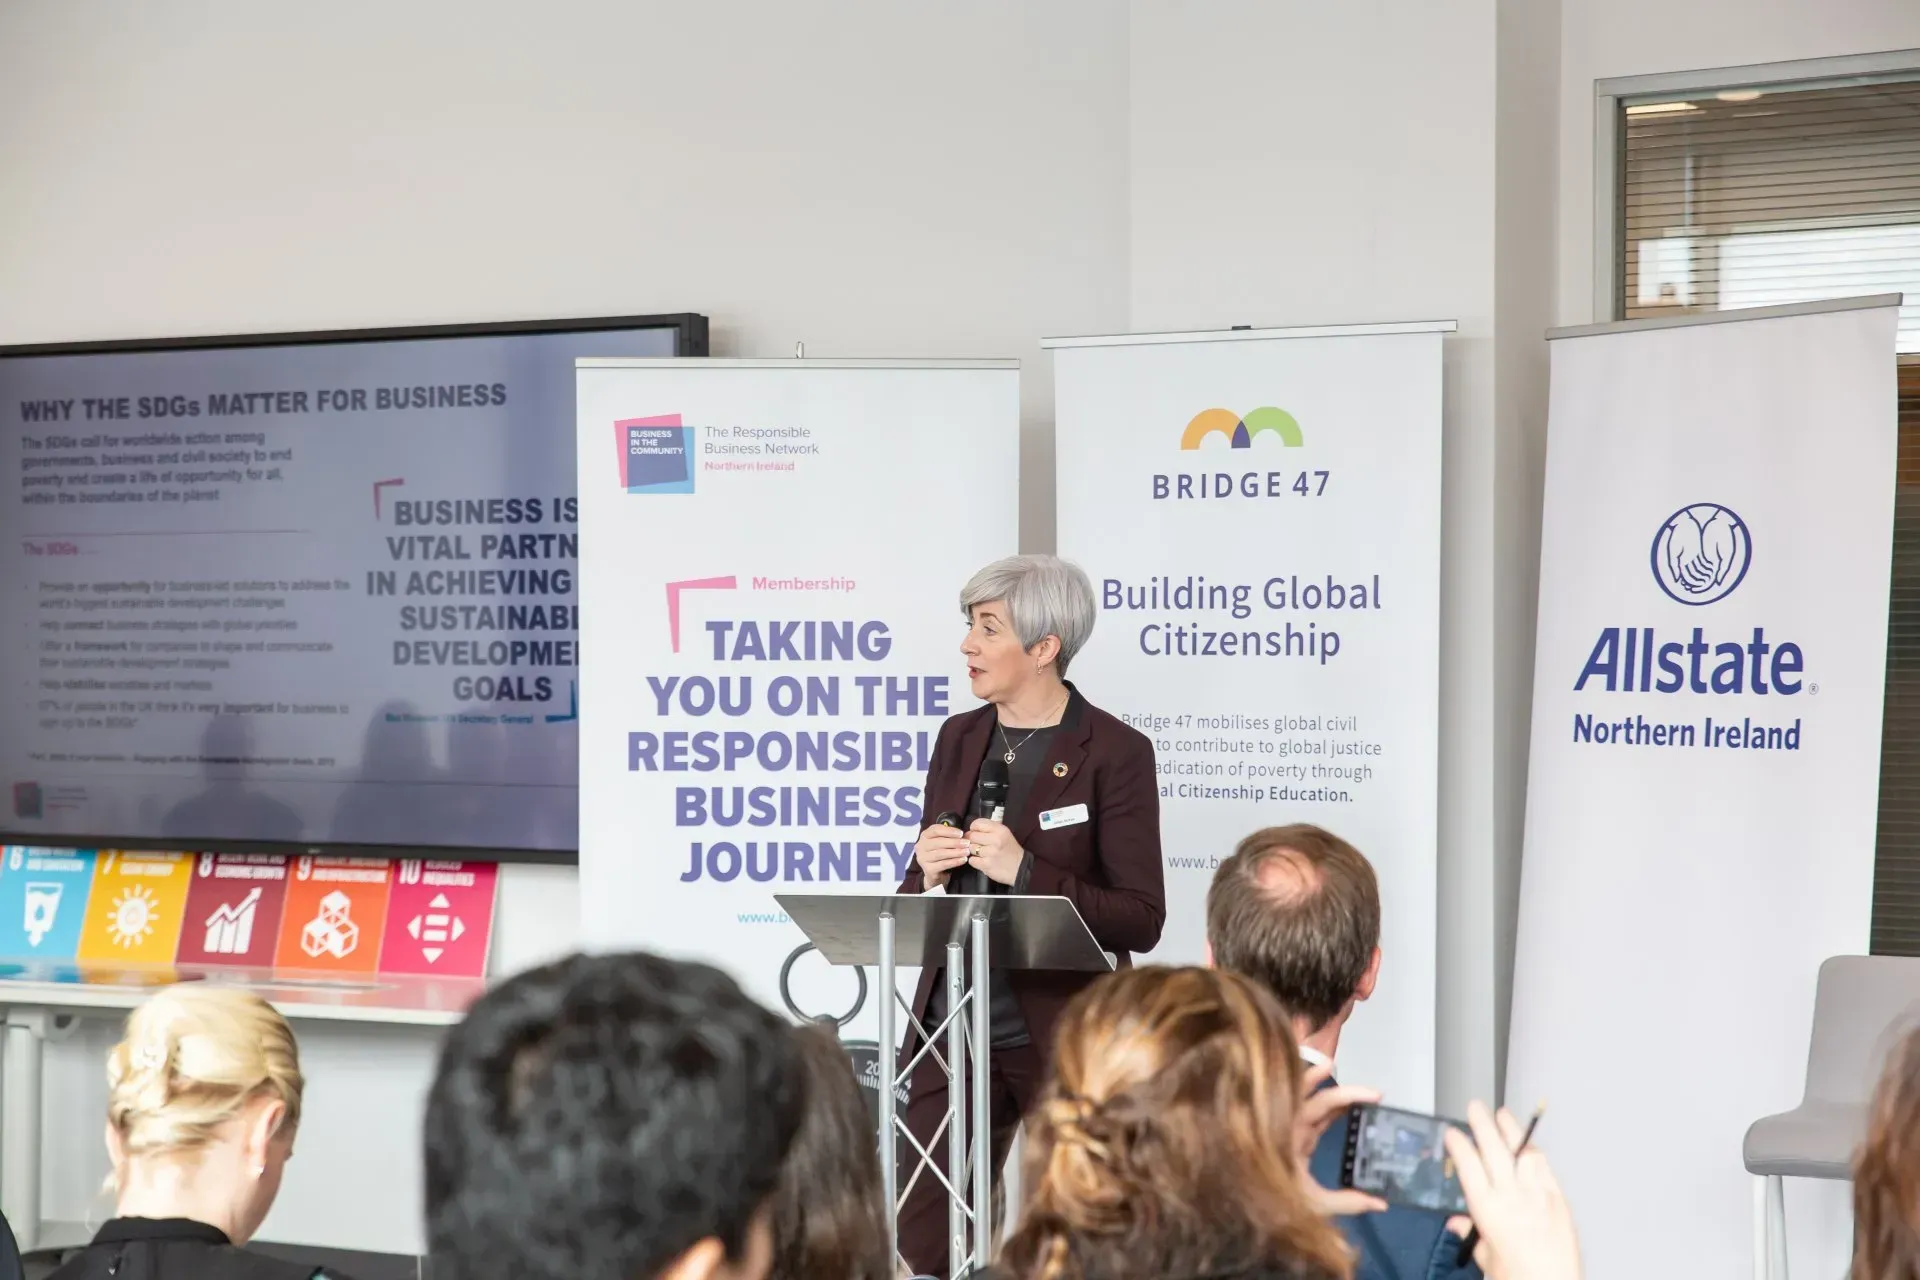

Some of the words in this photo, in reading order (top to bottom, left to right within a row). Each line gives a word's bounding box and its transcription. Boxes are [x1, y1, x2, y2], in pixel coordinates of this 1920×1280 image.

[20, 399, 75, 422] WHY
[82, 398, 130, 420] THE
[137, 396, 200, 418] SDGs
[209, 392, 309, 416] MATTER
[318, 388, 367, 412] FOR
[376, 384, 507, 409] BUSINESS
[630, 430, 672, 438] BUSINESS
[705, 426, 729, 438] The
[733, 426, 811, 441] Responsible
[631, 447, 684, 455] COMMUNITY
[705, 443, 761, 455] Business
[765, 443, 820, 455] Network
[705, 461, 754, 471] Northern
[756, 461, 795, 471] Ireland
[1152, 471, 1281, 499] BRIDGE
[1292, 470, 1330, 497] 47
[394, 499, 543, 525] BUSINESS
[553, 497, 578, 523] IS
[386, 535, 470, 561] VITAL
[481, 534, 578, 560] PARTN
[366, 571, 396, 595] IN
[405, 569, 571, 595] ACHIEVING
[752, 576, 856, 593] Membership
[1102, 576, 1252, 619] Building
[1263, 574, 1381, 609] Global
[705, 620, 892, 661] TAKING
[1139, 622, 1341, 665] Citizenship
[1573, 627, 1803, 695] Allstate
[453, 676, 553, 702] GOALS
[646, 676, 752, 716] YOU
[767, 676, 839, 716] ON
[854, 676, 949, 716] THE
[1122, 713, 1170, 732] Bridge
[1175, 715, 1192, 728] 47
[1197, 715, 1269, 730] mobilises
[1274, 715, 1322, 734] global
[1326, 716, 1357, 731] civil
[1573, 714, 1695, 747] Northern
[1704, 717, 1801, 750] Ireland
[627, 731, 932, 772] RESPONSIBL
[1156, 739, 1171, 752] to
[1175, 738, 1254, 753] contribute
[1259, 740, 1274, 753] to
[1279, 739, 1326, 758] global
[1330, 740, 1382, 758] justice
[1155, 760, 1223, 776] adication
[1228, 760, 1243, 776] of
[1248, 763, 1307, 780] poverty
[1312, 764, 1372, 782] through
[1178, 783, 1264, 803] Citizenship
[1270, 786, 1354, 803] Education.
[675, 786, 922, 827] BUSINESS
[198, 852, 214, 878] 8
[297, 855, 312, 881] 9
[399, 858, 422, 885] 10
[680, 841, 915, 882] JOURNEY
[1168, 855, 1220, 870] www.b
[737, 910, 791, 923] www.b
